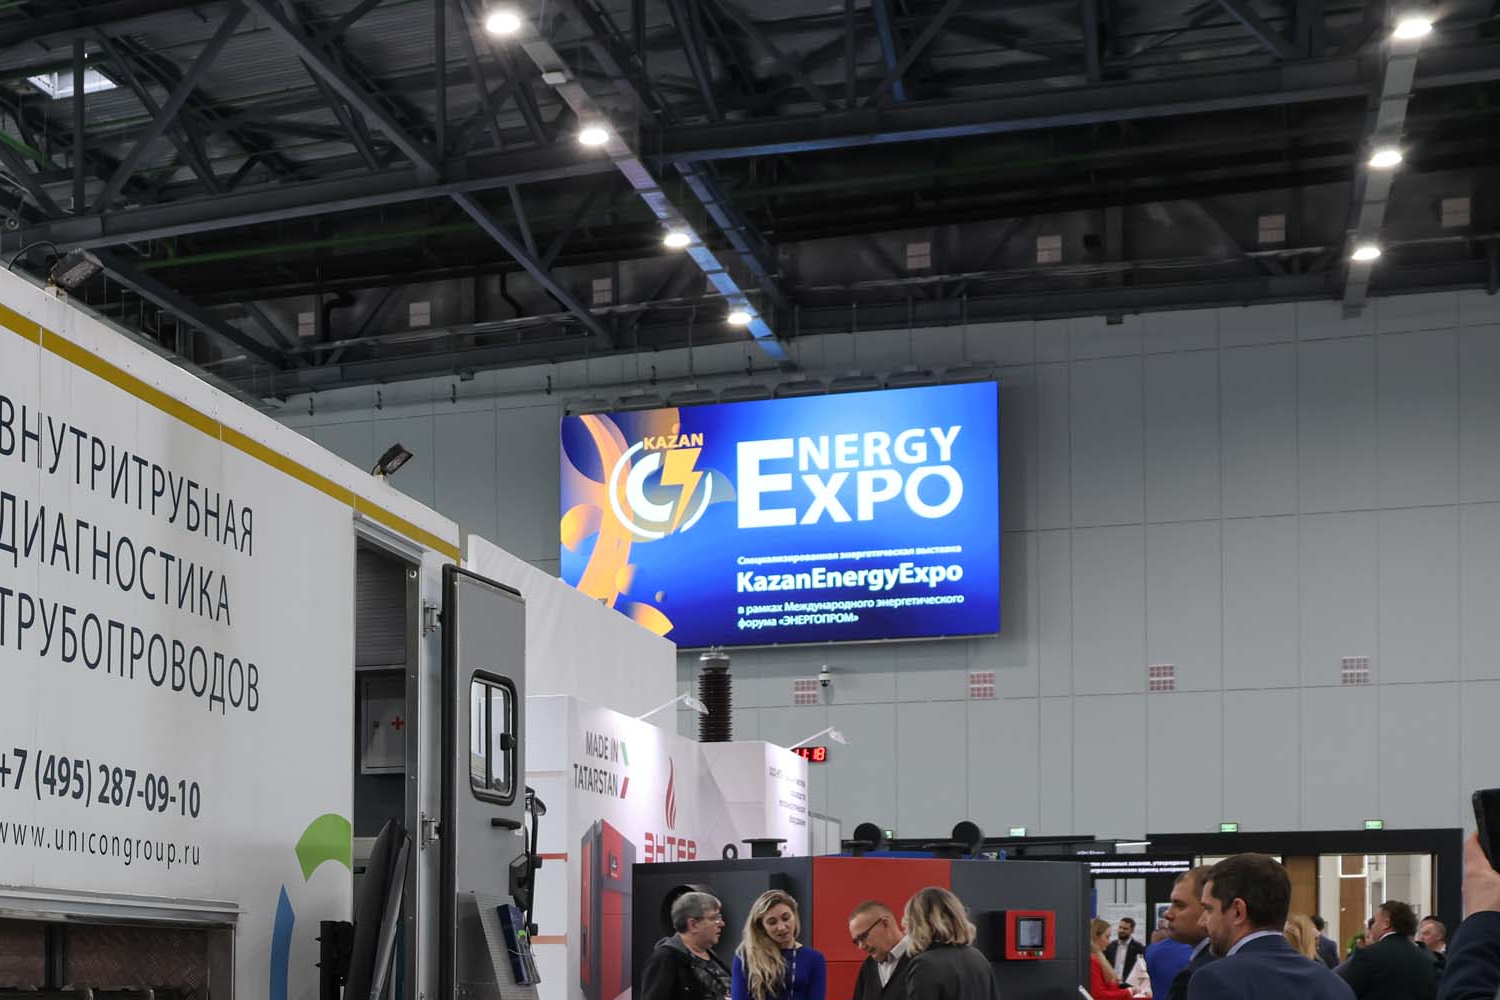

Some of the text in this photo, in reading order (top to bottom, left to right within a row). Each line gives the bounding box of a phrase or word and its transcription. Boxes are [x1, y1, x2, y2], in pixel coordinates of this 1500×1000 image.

[643, 432, 704, 451] KAZAN
[736, 562, 964, 592] KazanEnergyExpo
[738, 594, 965, 616] в рамках Международного энергетического
[738, 612, 859, 630] форума «ЭНЕРГОПРОМ»
[586, 731, 618, 763] MADE IN
[35, 750, 92, 807] (495)
[98, 764, 201, 818] 287-09-10
[573, 763, 618, 797] TATARSTAN
[644, 832, 697, 863] ЭНТЕР
